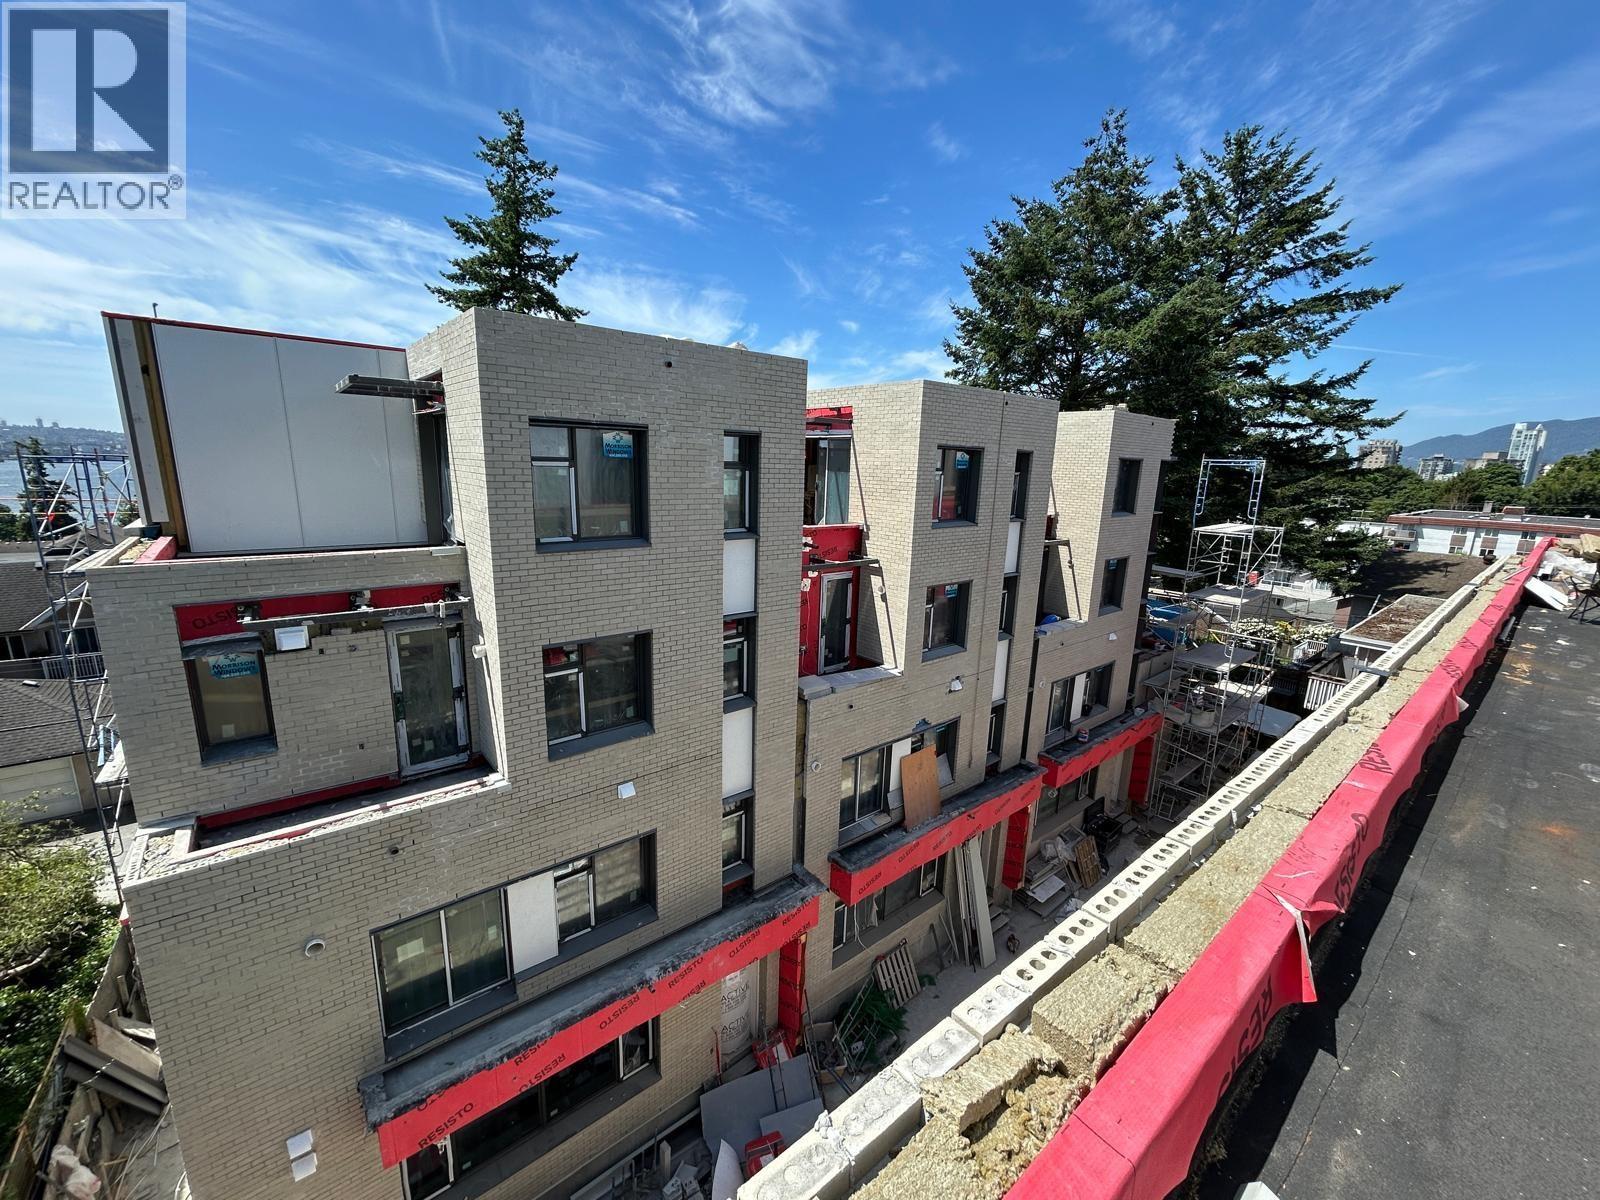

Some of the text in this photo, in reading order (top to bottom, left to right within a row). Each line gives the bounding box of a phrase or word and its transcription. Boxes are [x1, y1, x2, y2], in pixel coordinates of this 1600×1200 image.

[212, 660, 257, 672] MORRISON
[728, 928, 761, 959] RESISTO
[667, 956, 704, 989] RESISTO
[599, 993, 641, 1030] RESISTO
[721, 1014, 745, 1033] ACTIV
[417, 1102, 475, 1149] RESISTO
